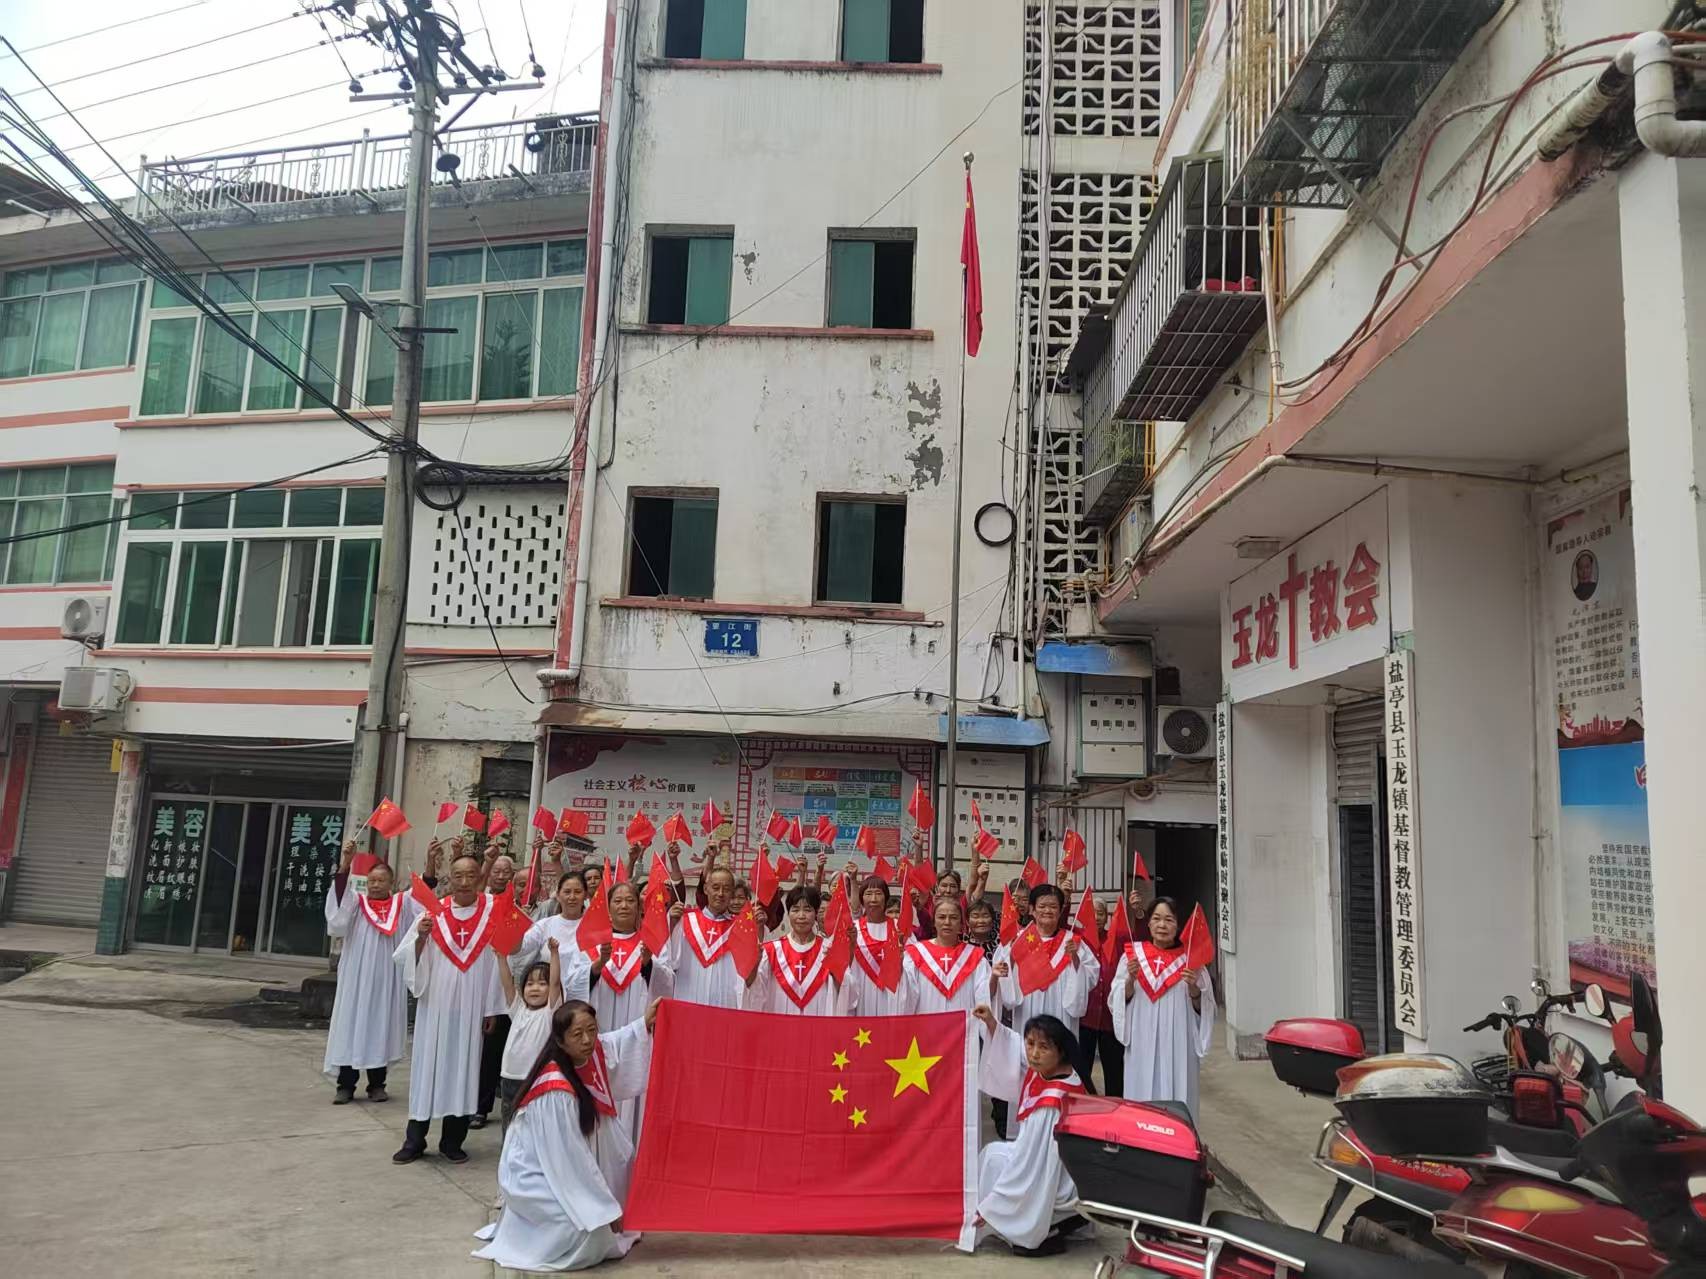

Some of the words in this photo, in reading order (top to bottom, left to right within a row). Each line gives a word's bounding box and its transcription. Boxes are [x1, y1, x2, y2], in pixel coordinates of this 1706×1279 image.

[721, 632, 742, 648] 12
[584, 774, 696, 793] 社会主义核心价值观
[154, 806, 205, 837] 美容
[290, 813, 343, 846] 美发
[1388, 659, 1417, 1028] 盐亭县玉龙镇基督教管理委员会
